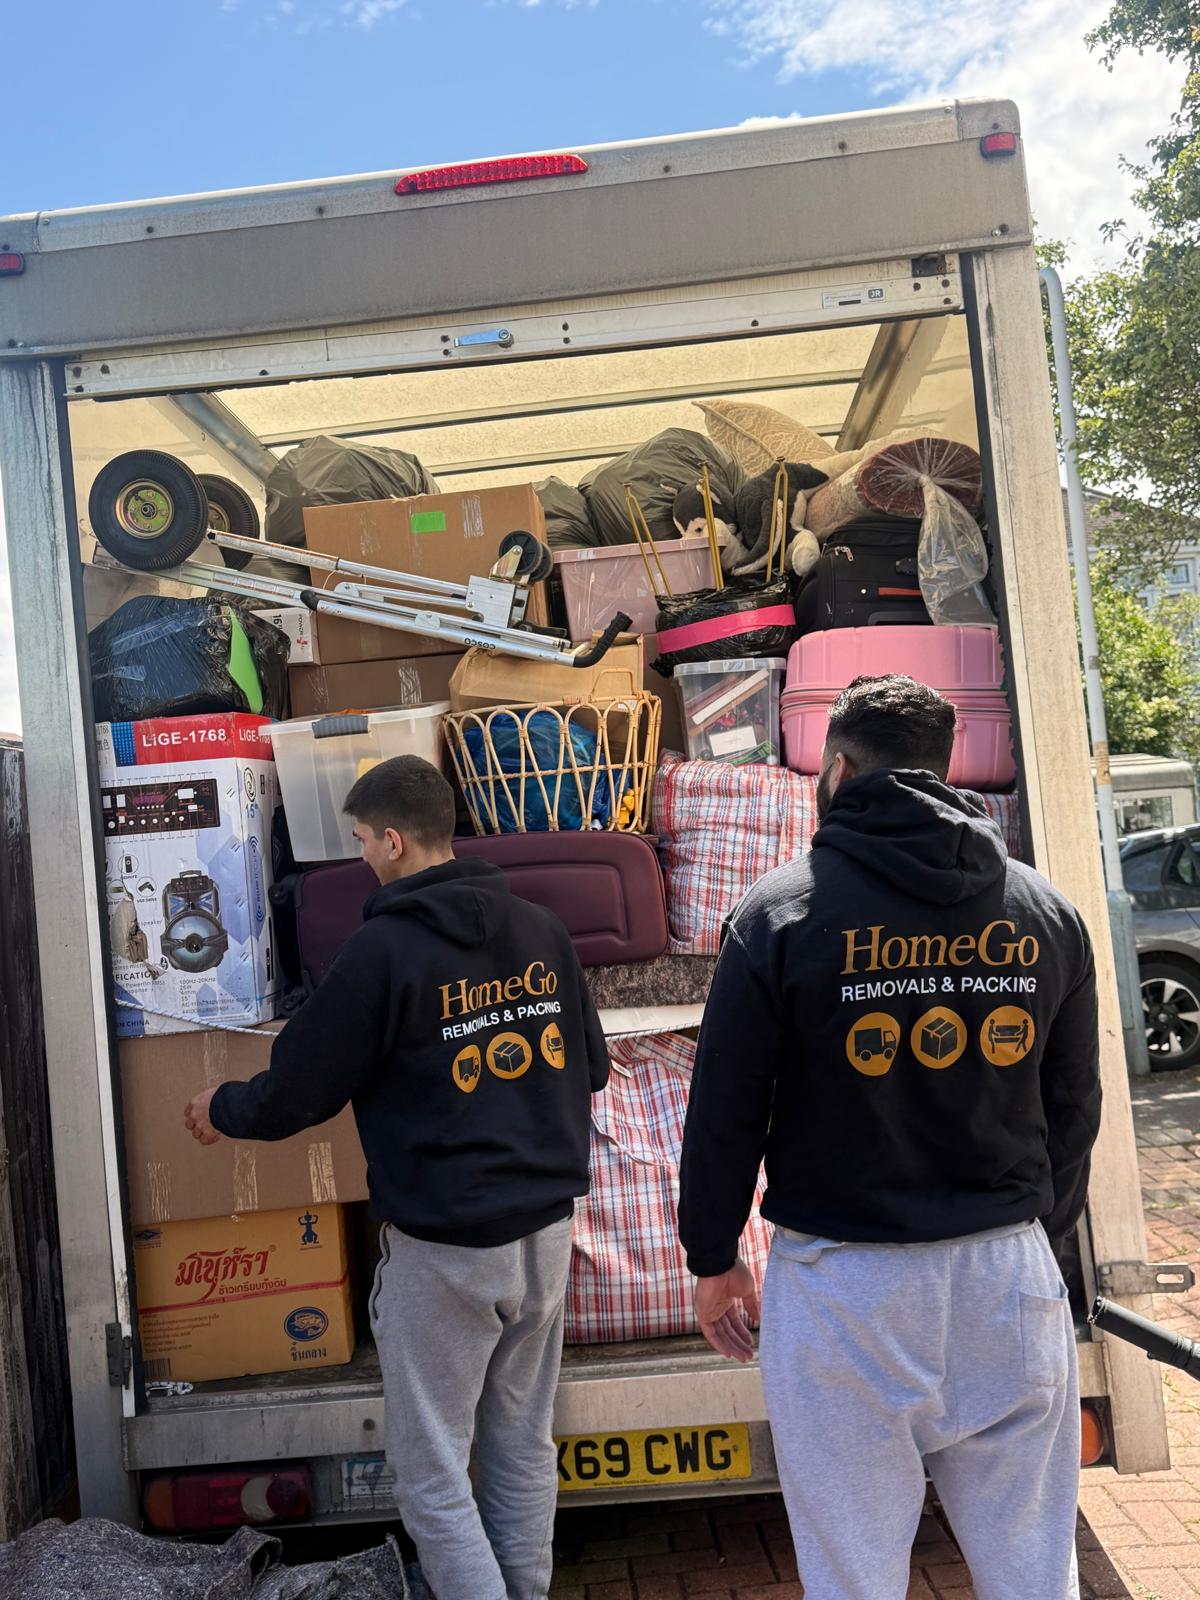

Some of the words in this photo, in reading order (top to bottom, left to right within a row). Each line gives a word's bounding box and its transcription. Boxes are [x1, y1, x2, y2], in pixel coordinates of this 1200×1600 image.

[464, 637, 496, 650] COSCO
[142, 728, 227, 748] LiGE-1768
[840, 919, 1040, 975] HomeGo
[438, 961, 558, 1020] HomeGo
[841, 977, 936, 1002] REMOVALS
[940, 976, 955, 993] &
[960, 976, 1037, 993] PACKING
[442, 1012, 500, 1041] REMOVALS
[503, 1009, 515, 1023] &
[644, 1429, 731, 1476] CWG
